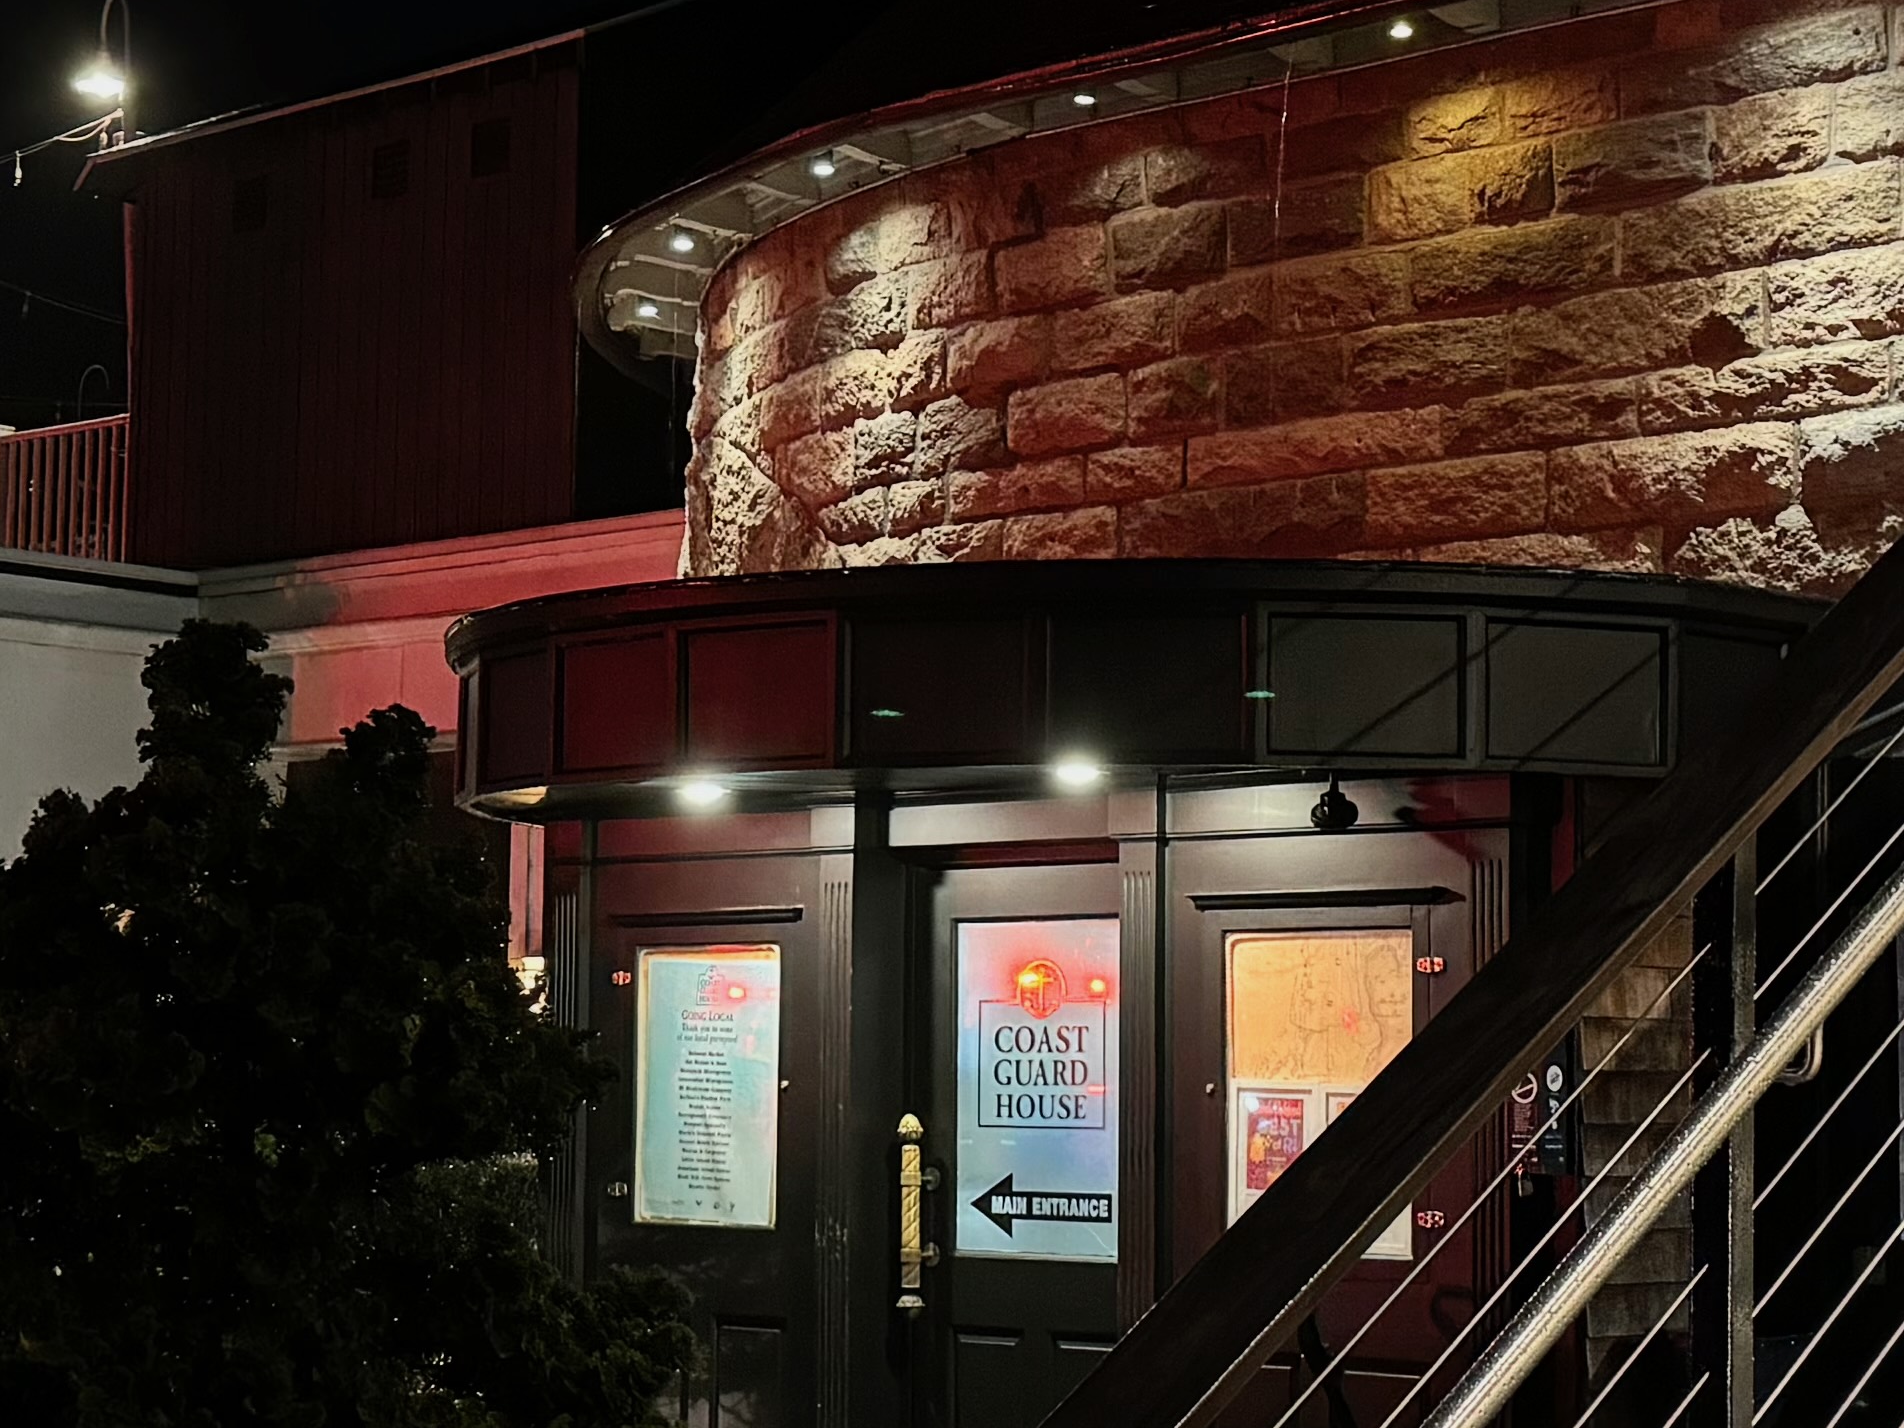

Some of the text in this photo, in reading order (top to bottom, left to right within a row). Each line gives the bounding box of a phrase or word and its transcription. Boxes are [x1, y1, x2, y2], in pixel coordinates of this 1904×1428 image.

[994, 1025, 1089, 1053] COAST
[994, 1059, 1088, 1086] GUARD
[995, 1094, 1088, 1119] HOUSE
[991, 1195, 1109, 1218] MAIN ENTRANCE
